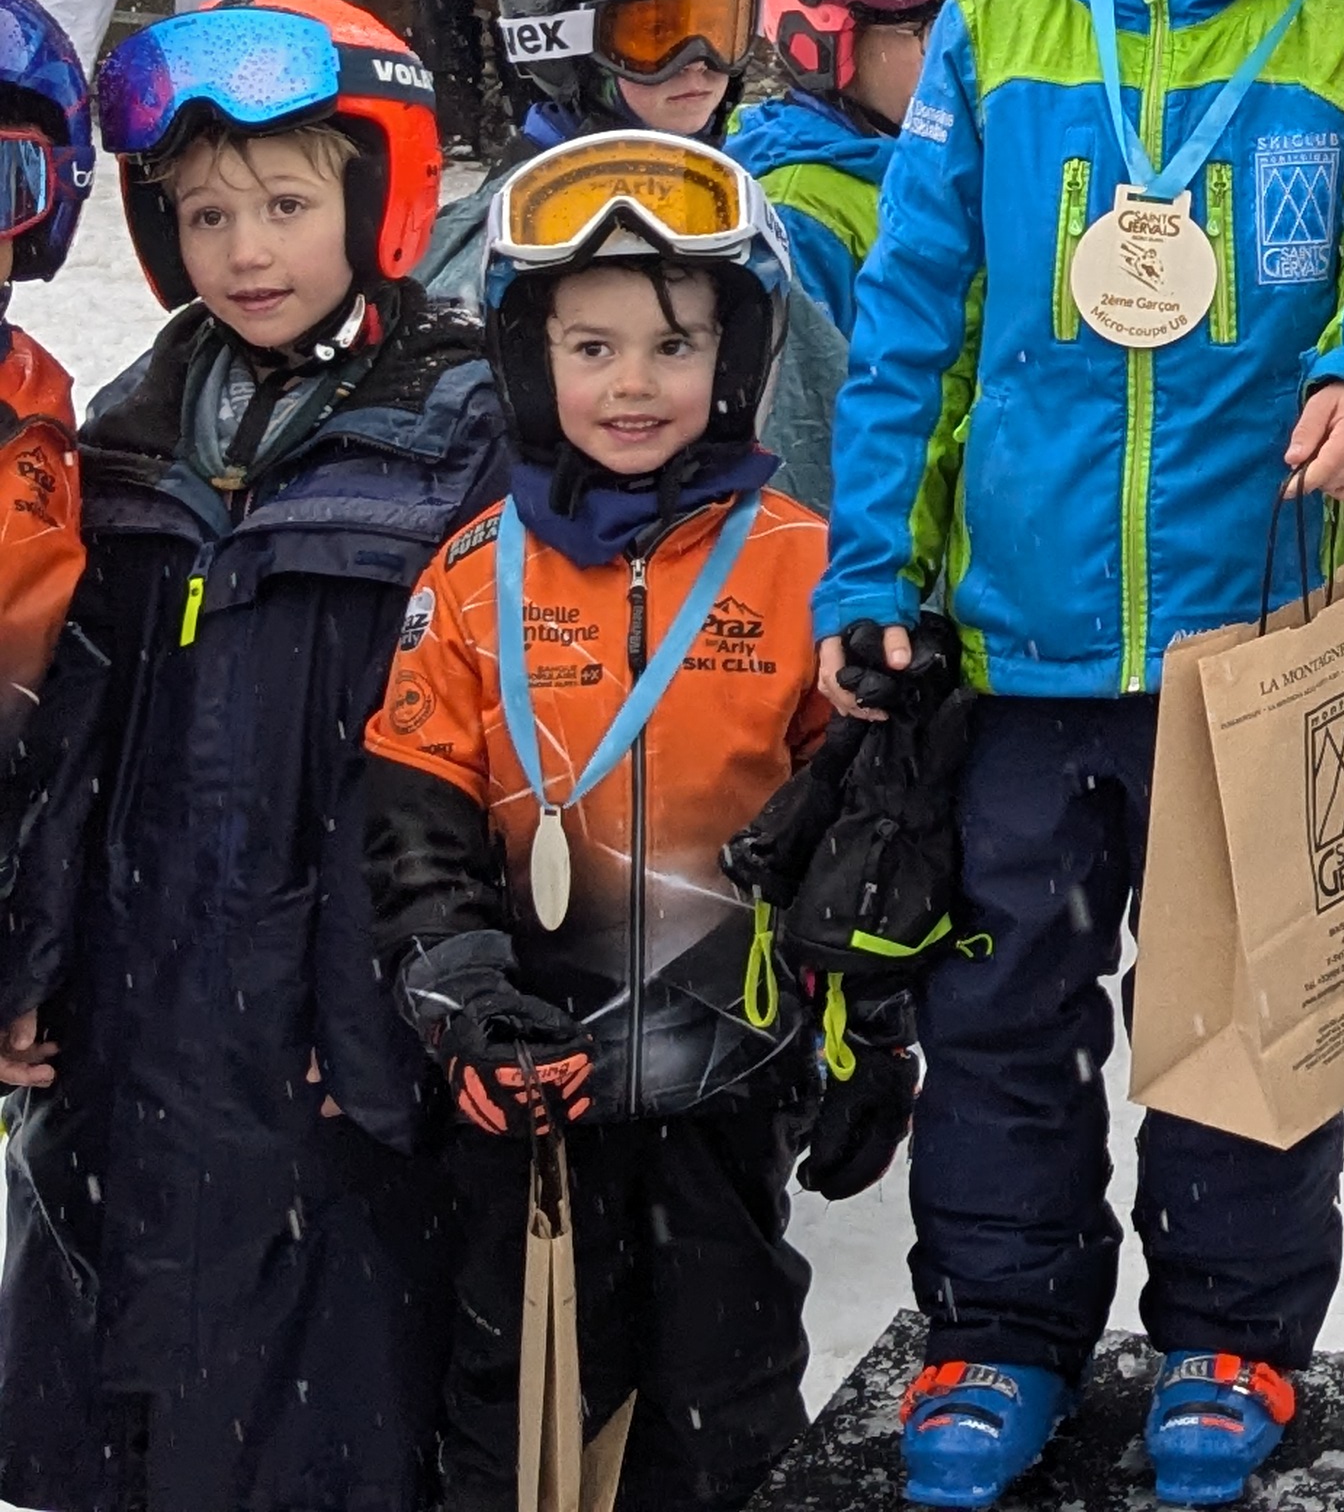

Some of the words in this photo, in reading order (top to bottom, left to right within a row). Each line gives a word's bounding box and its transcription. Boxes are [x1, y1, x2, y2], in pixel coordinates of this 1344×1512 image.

[1136, 297, 1180, 312] Garçon
[1090, 306, 1167, 337] Micro-coupe
[716, 640, 756, 658] Arly
[682, 657, 716, 671] SKI
[721, 659, 777, 674] CLUB
[1259, 679, 1280, 697] LA
